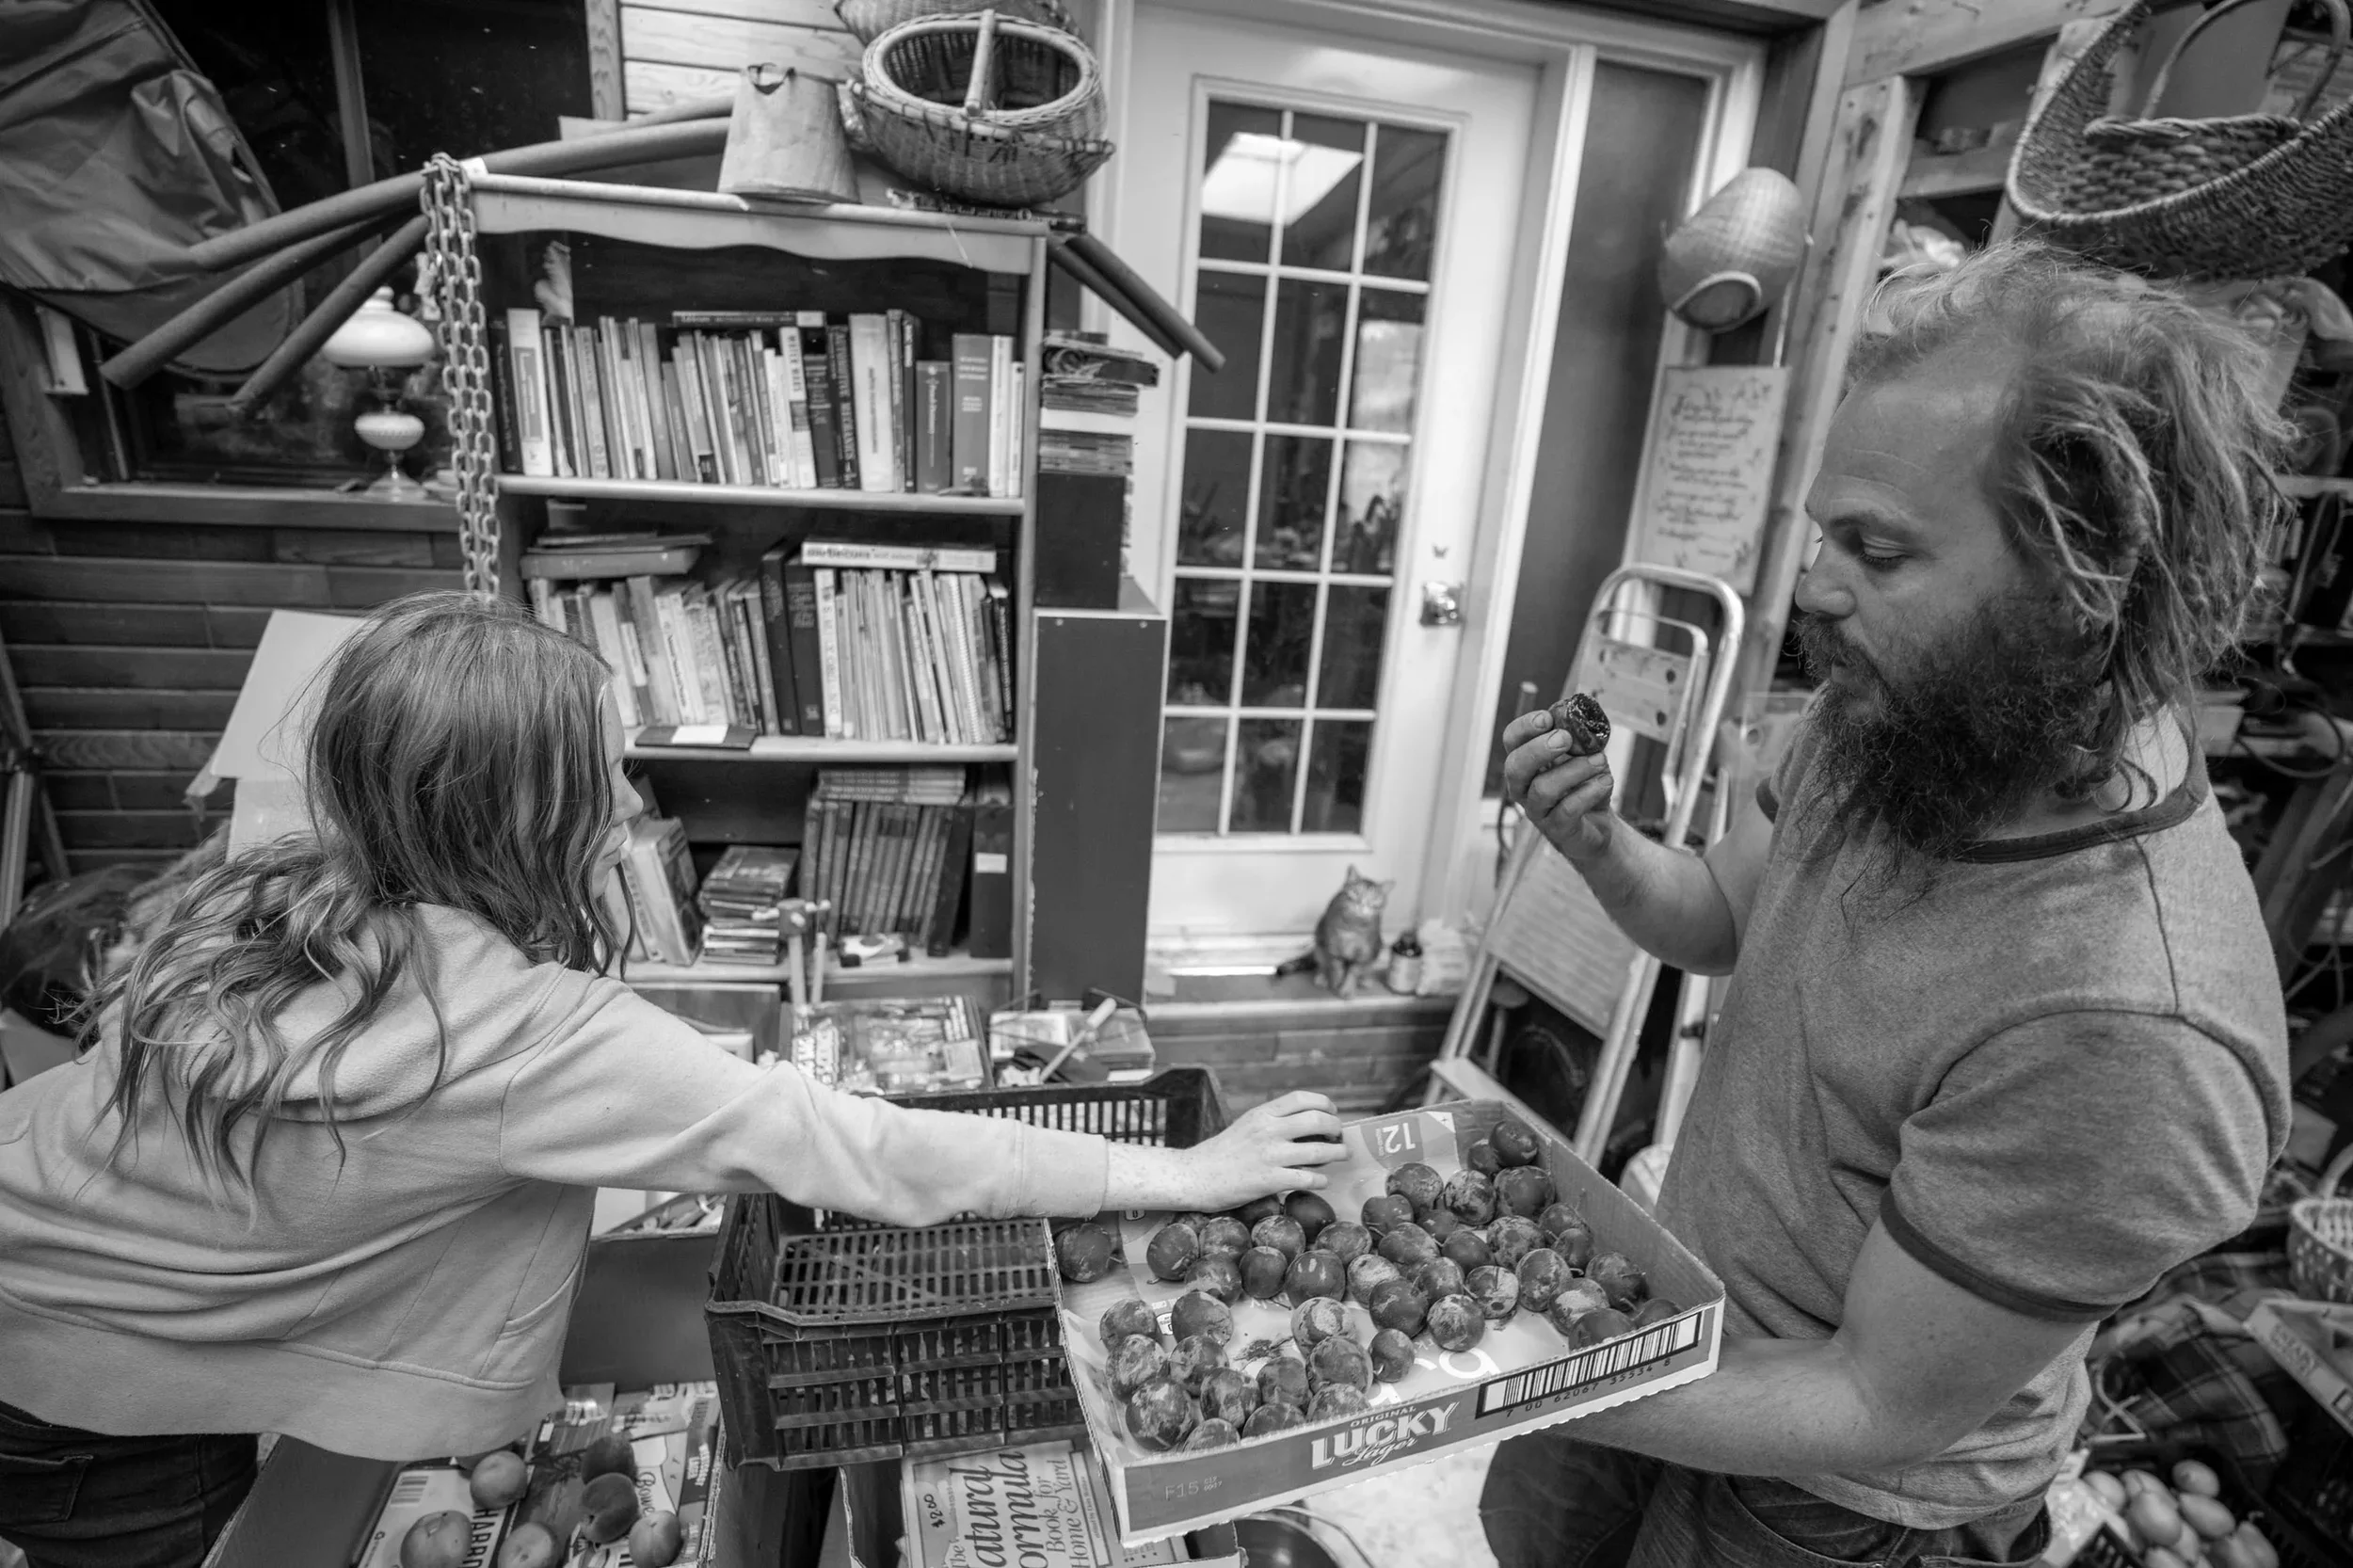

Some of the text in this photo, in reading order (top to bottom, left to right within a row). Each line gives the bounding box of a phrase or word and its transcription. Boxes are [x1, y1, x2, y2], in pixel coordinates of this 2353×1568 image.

[1382, 1122, 1417, 1154] 12
[1311, 1400, 1460, 1469] LUCKY
[1350, 1405, 1417, 1428] ORIGINAL
[1506, 1407, 1513, 1418] 7
[1525, 1400, 1543, 1412] 00
[1553, 1383, 1599, 1403] 62067
[1342, 1437, 1417, 1466] Lager
[948, 1464, 1007, 1568] atural
[997, 1450, 1048, 1568] ormula
[1033, 1476, 1066, 1553] Book for
[1046, 1459, 1091, 1568] Home & Yard
